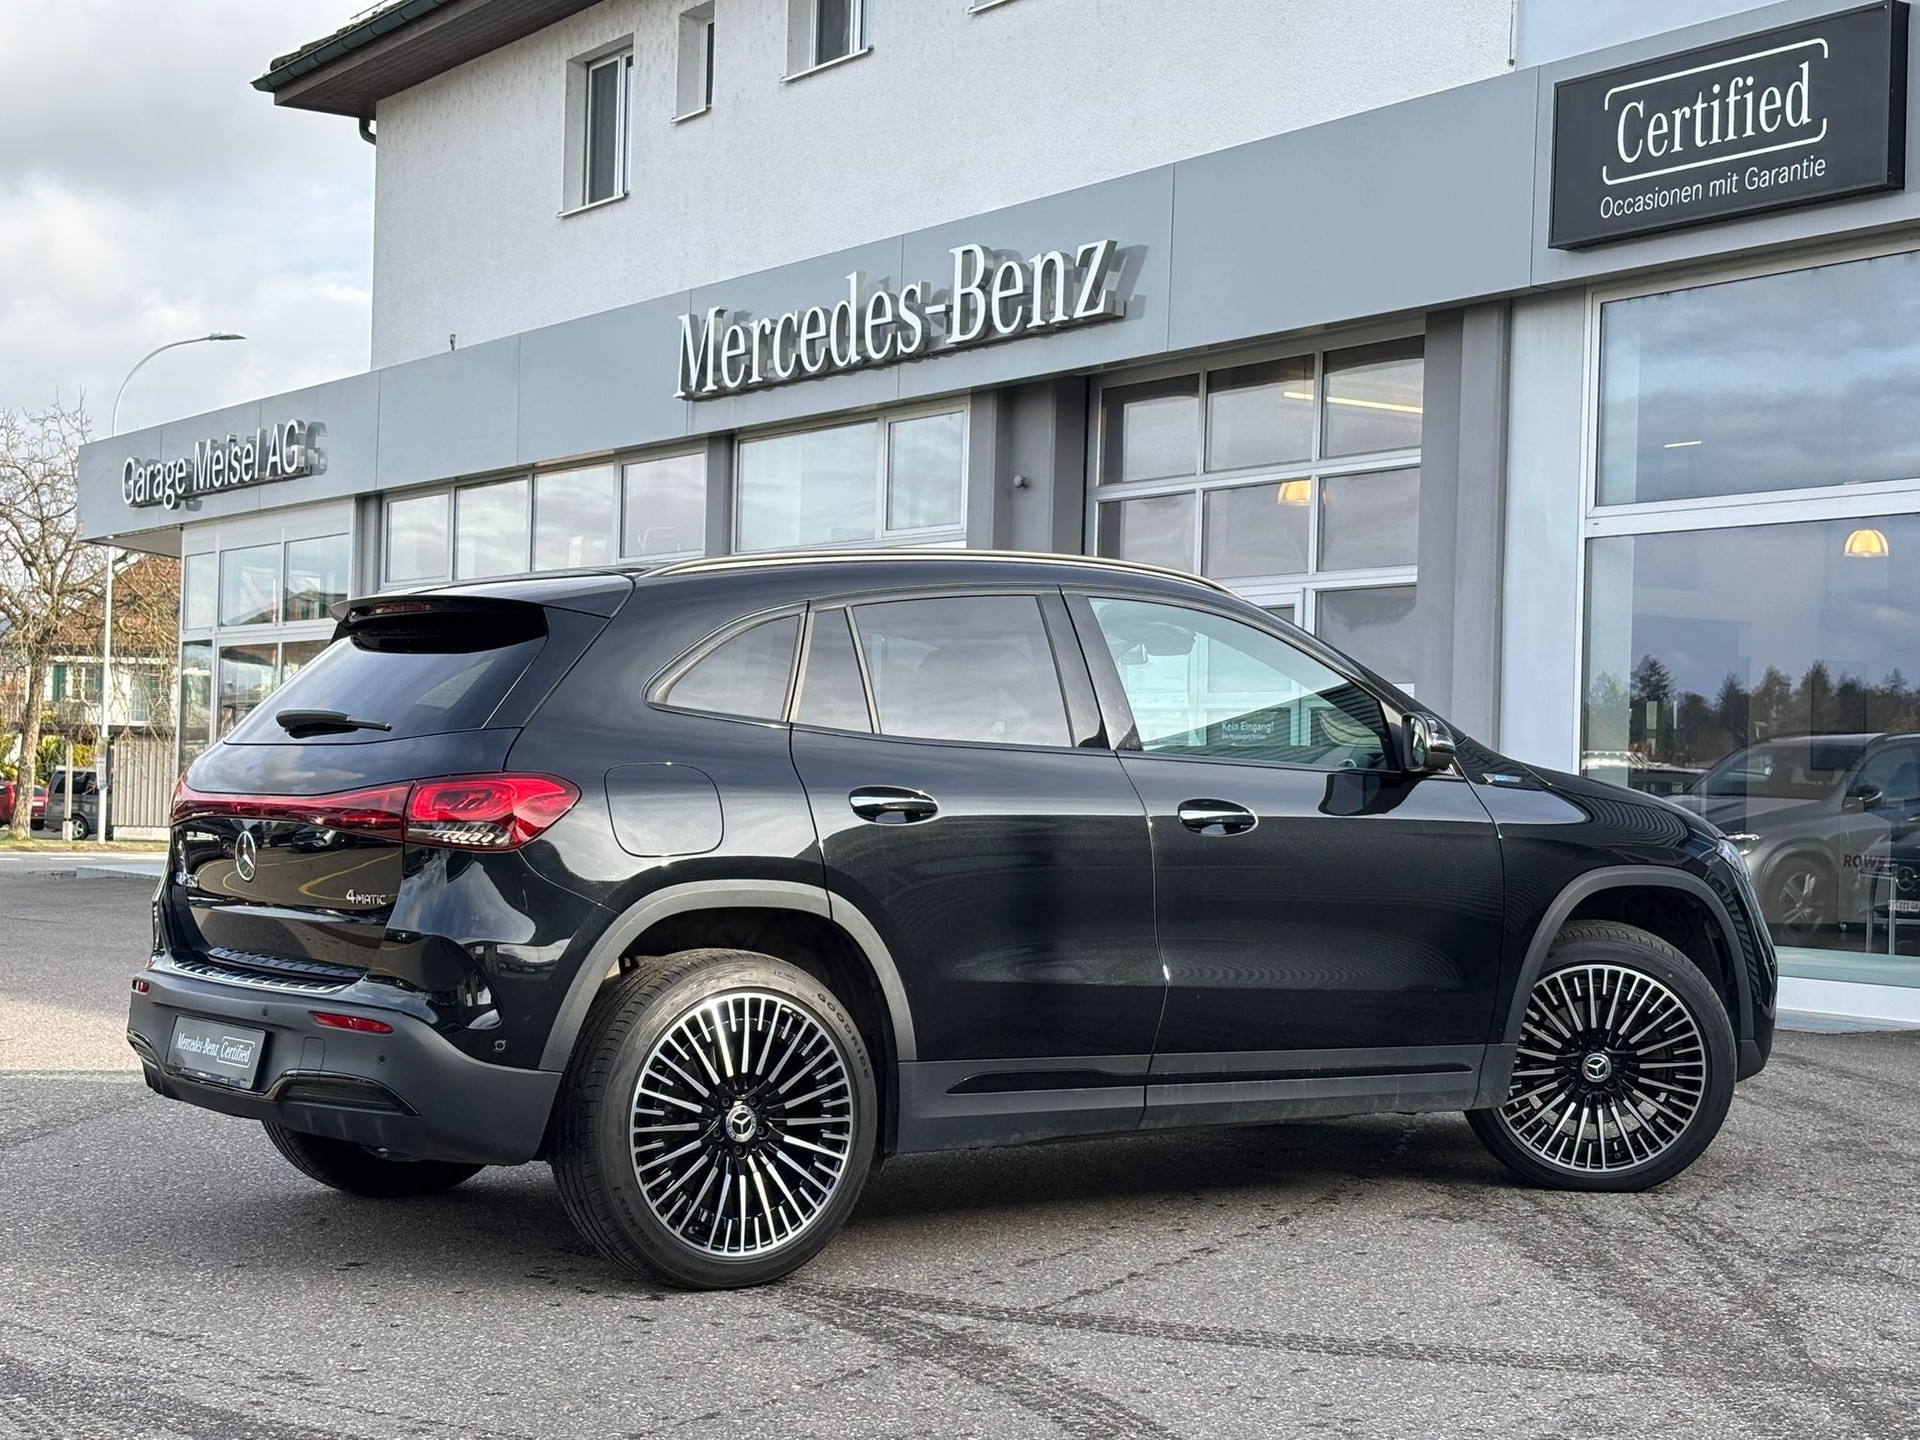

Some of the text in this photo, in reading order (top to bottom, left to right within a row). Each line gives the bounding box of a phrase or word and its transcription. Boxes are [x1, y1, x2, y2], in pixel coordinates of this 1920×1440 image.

[1616, 61, 1812, 164] Certified
[1600, 154, 1826, 219] Occasionen mit Garantie
[673, 239, 1118, 399] Mercedes-Benz
[122, 419, 300, 510] Garage Meisel AG
[1221, 721, 1239, 731] Kein
[346, 889, 387, 905] 4MATIC
[175, 1032, 252, 1062] Mercedes-Benz Certified
[817, 993, 871, 1079] GOODRIDE
